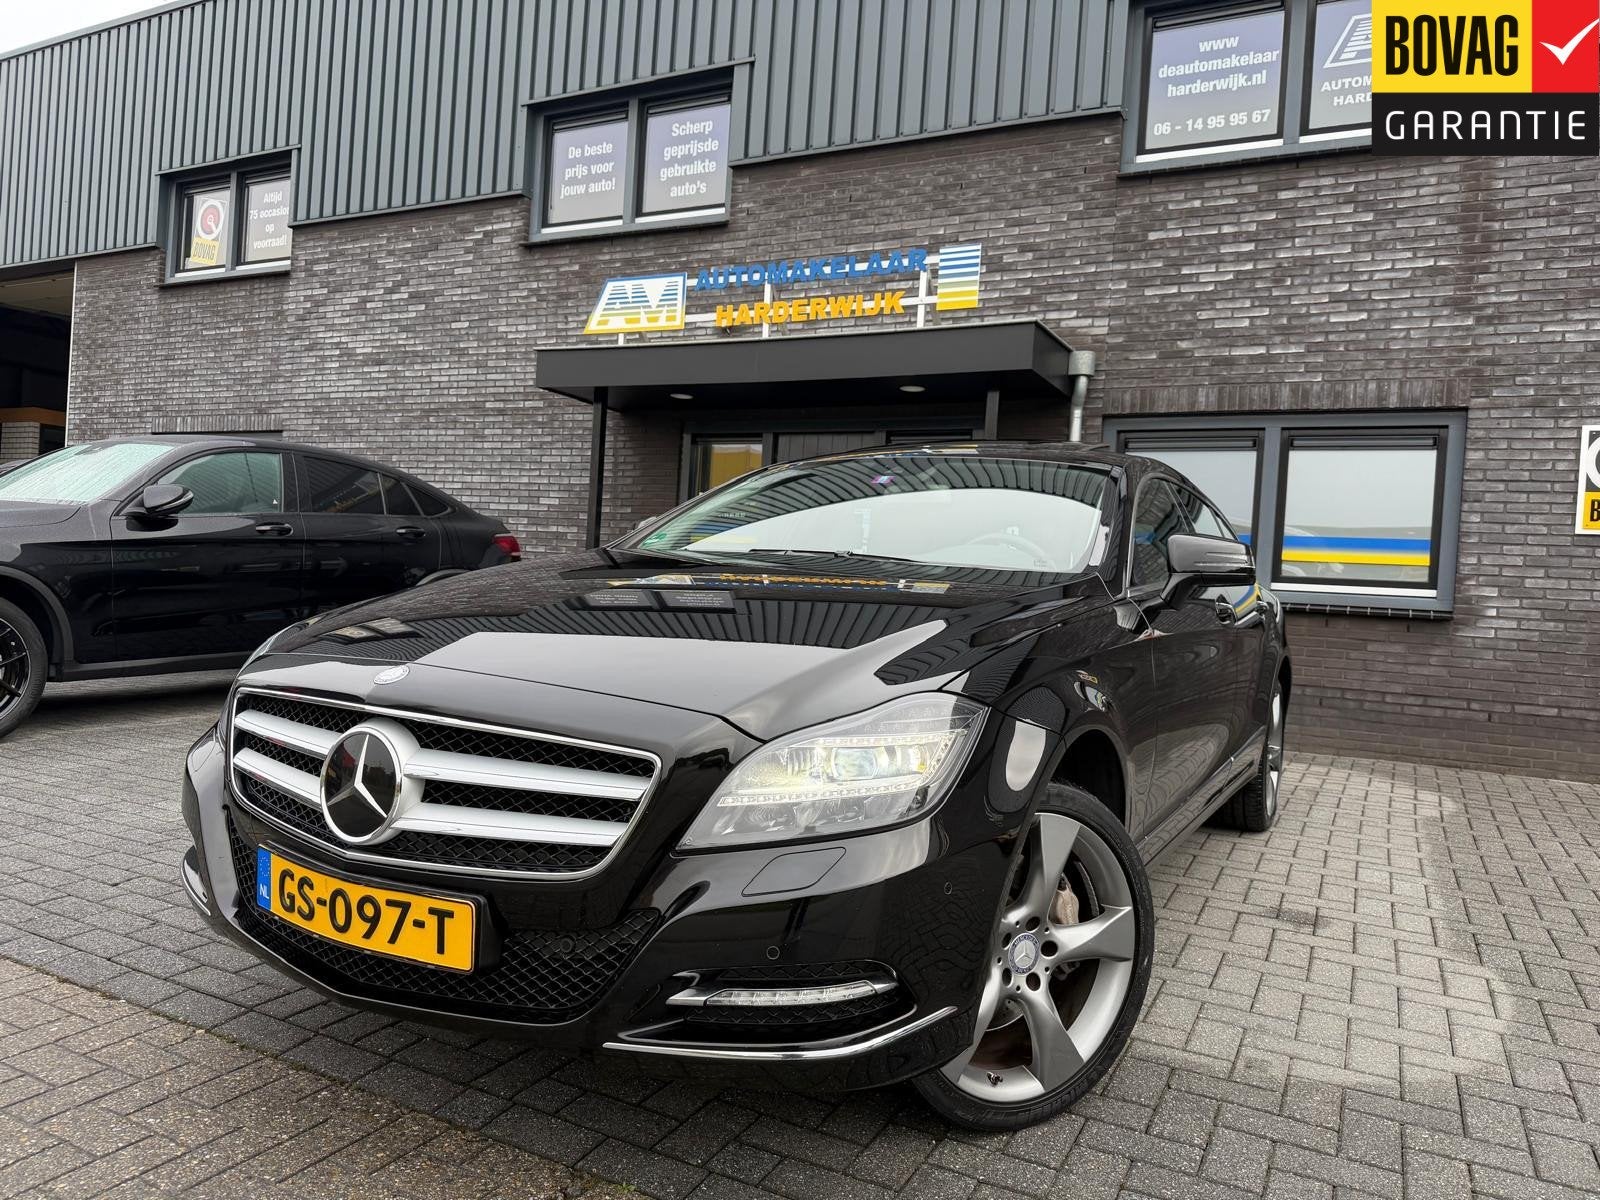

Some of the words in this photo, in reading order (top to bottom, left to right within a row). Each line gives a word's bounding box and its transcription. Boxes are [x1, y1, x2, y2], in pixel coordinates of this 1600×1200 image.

[1199, 35, 1240, 53] www
[1158, 49, 1280, 79] deautomakelaar
[1167, 69, 1267, 97] harderwijk.nl
[671, 120, 713, 137] Scherp
[1154, 122, 1171, 136] 06
[1186, 118, 1203, 132] 14
[1208, 114, 1225, 129] 95
[1229, 111, 1248, 126] 95
[1252, 108, 1271, 124] 67
[568, 146, 582, 159] De
[584, 142, 613, 157] beste
[663, 138, 719, 161] geprijsde
[565, 164, 588, 181] prijs
[591, 161, 615, 174] voor
[660, 159, 717, 181] gebruikte
[263, 191, 283, 204] Altijd
[560, 183, 587, 199] jouw
[588, 178, 616, 193] auto!
[670, 180, 707, 197] auto's
[249, 209, 258, 220] 75
[265, 223, 274, 234] op
[192, 242, 216, 261] BOVAG
[253, 235, 288, 249] voorraad!
[693, 247, 928, 291] AUTOMAKELAAR
[714, 290, 906, 327] HARDERWIJK
[259, 883, 270, 900] NL
[278, 867, 455, 955] GS-097-T
